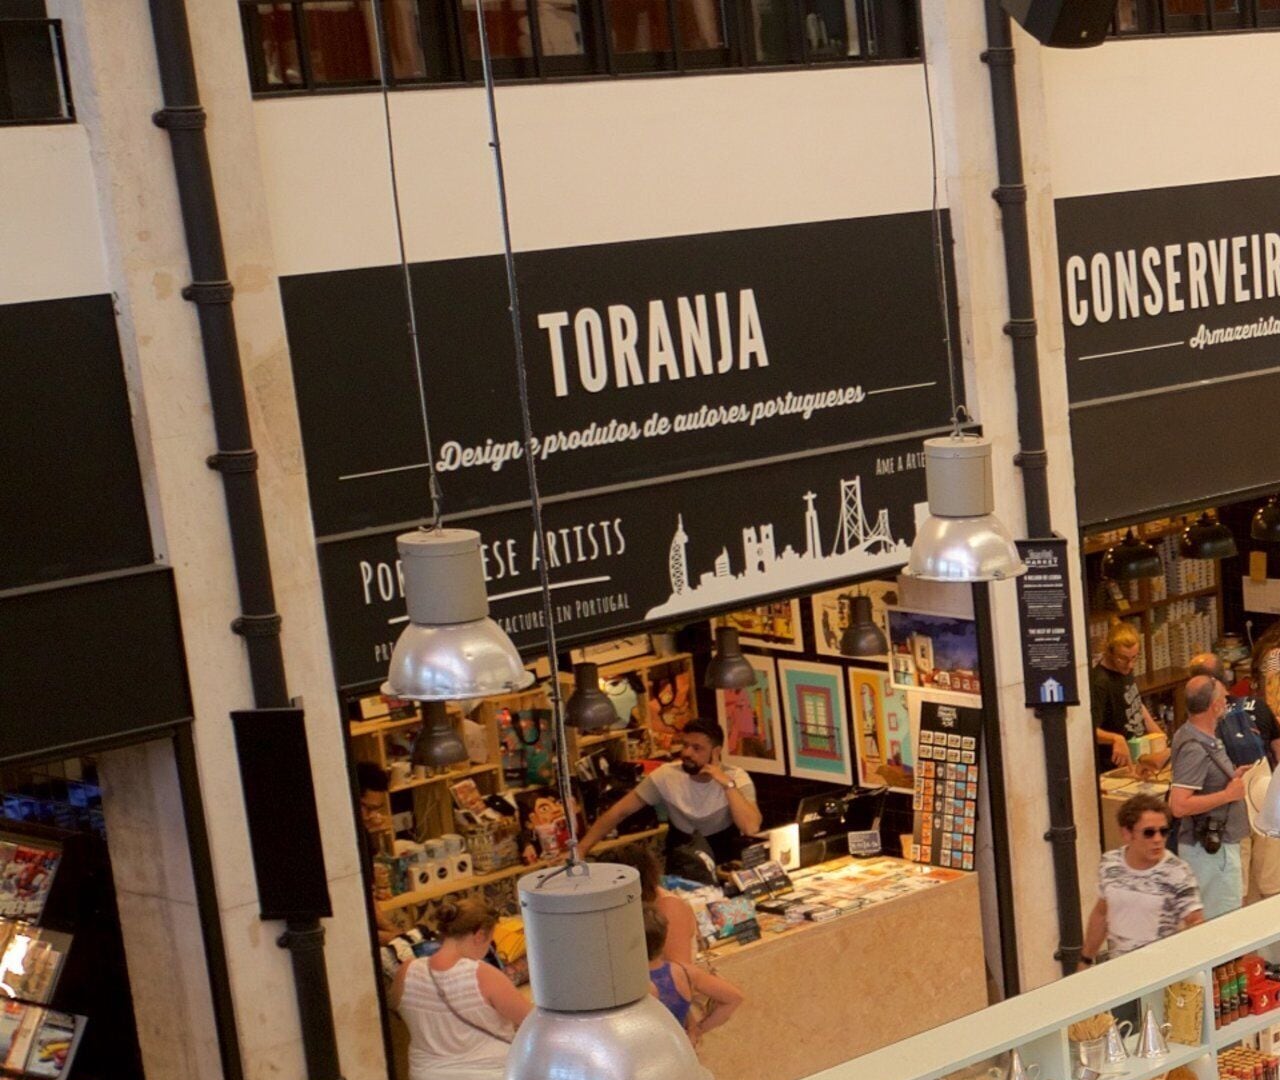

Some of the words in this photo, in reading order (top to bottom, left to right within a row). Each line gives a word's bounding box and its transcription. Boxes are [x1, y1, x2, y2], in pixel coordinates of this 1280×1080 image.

[537, 288, 769, 397] TORANJA
[435, 440, 523, 472] Design
[541, 421, 640, 461] produtos
[643, 412, 669, 438] de
[673, 403, 751, 432] autores
[750, 385, 867, 425] portugueses
[531, 518, 627, 571] ARTISTS
[575, 593, 630, 621] PORTUGAL
